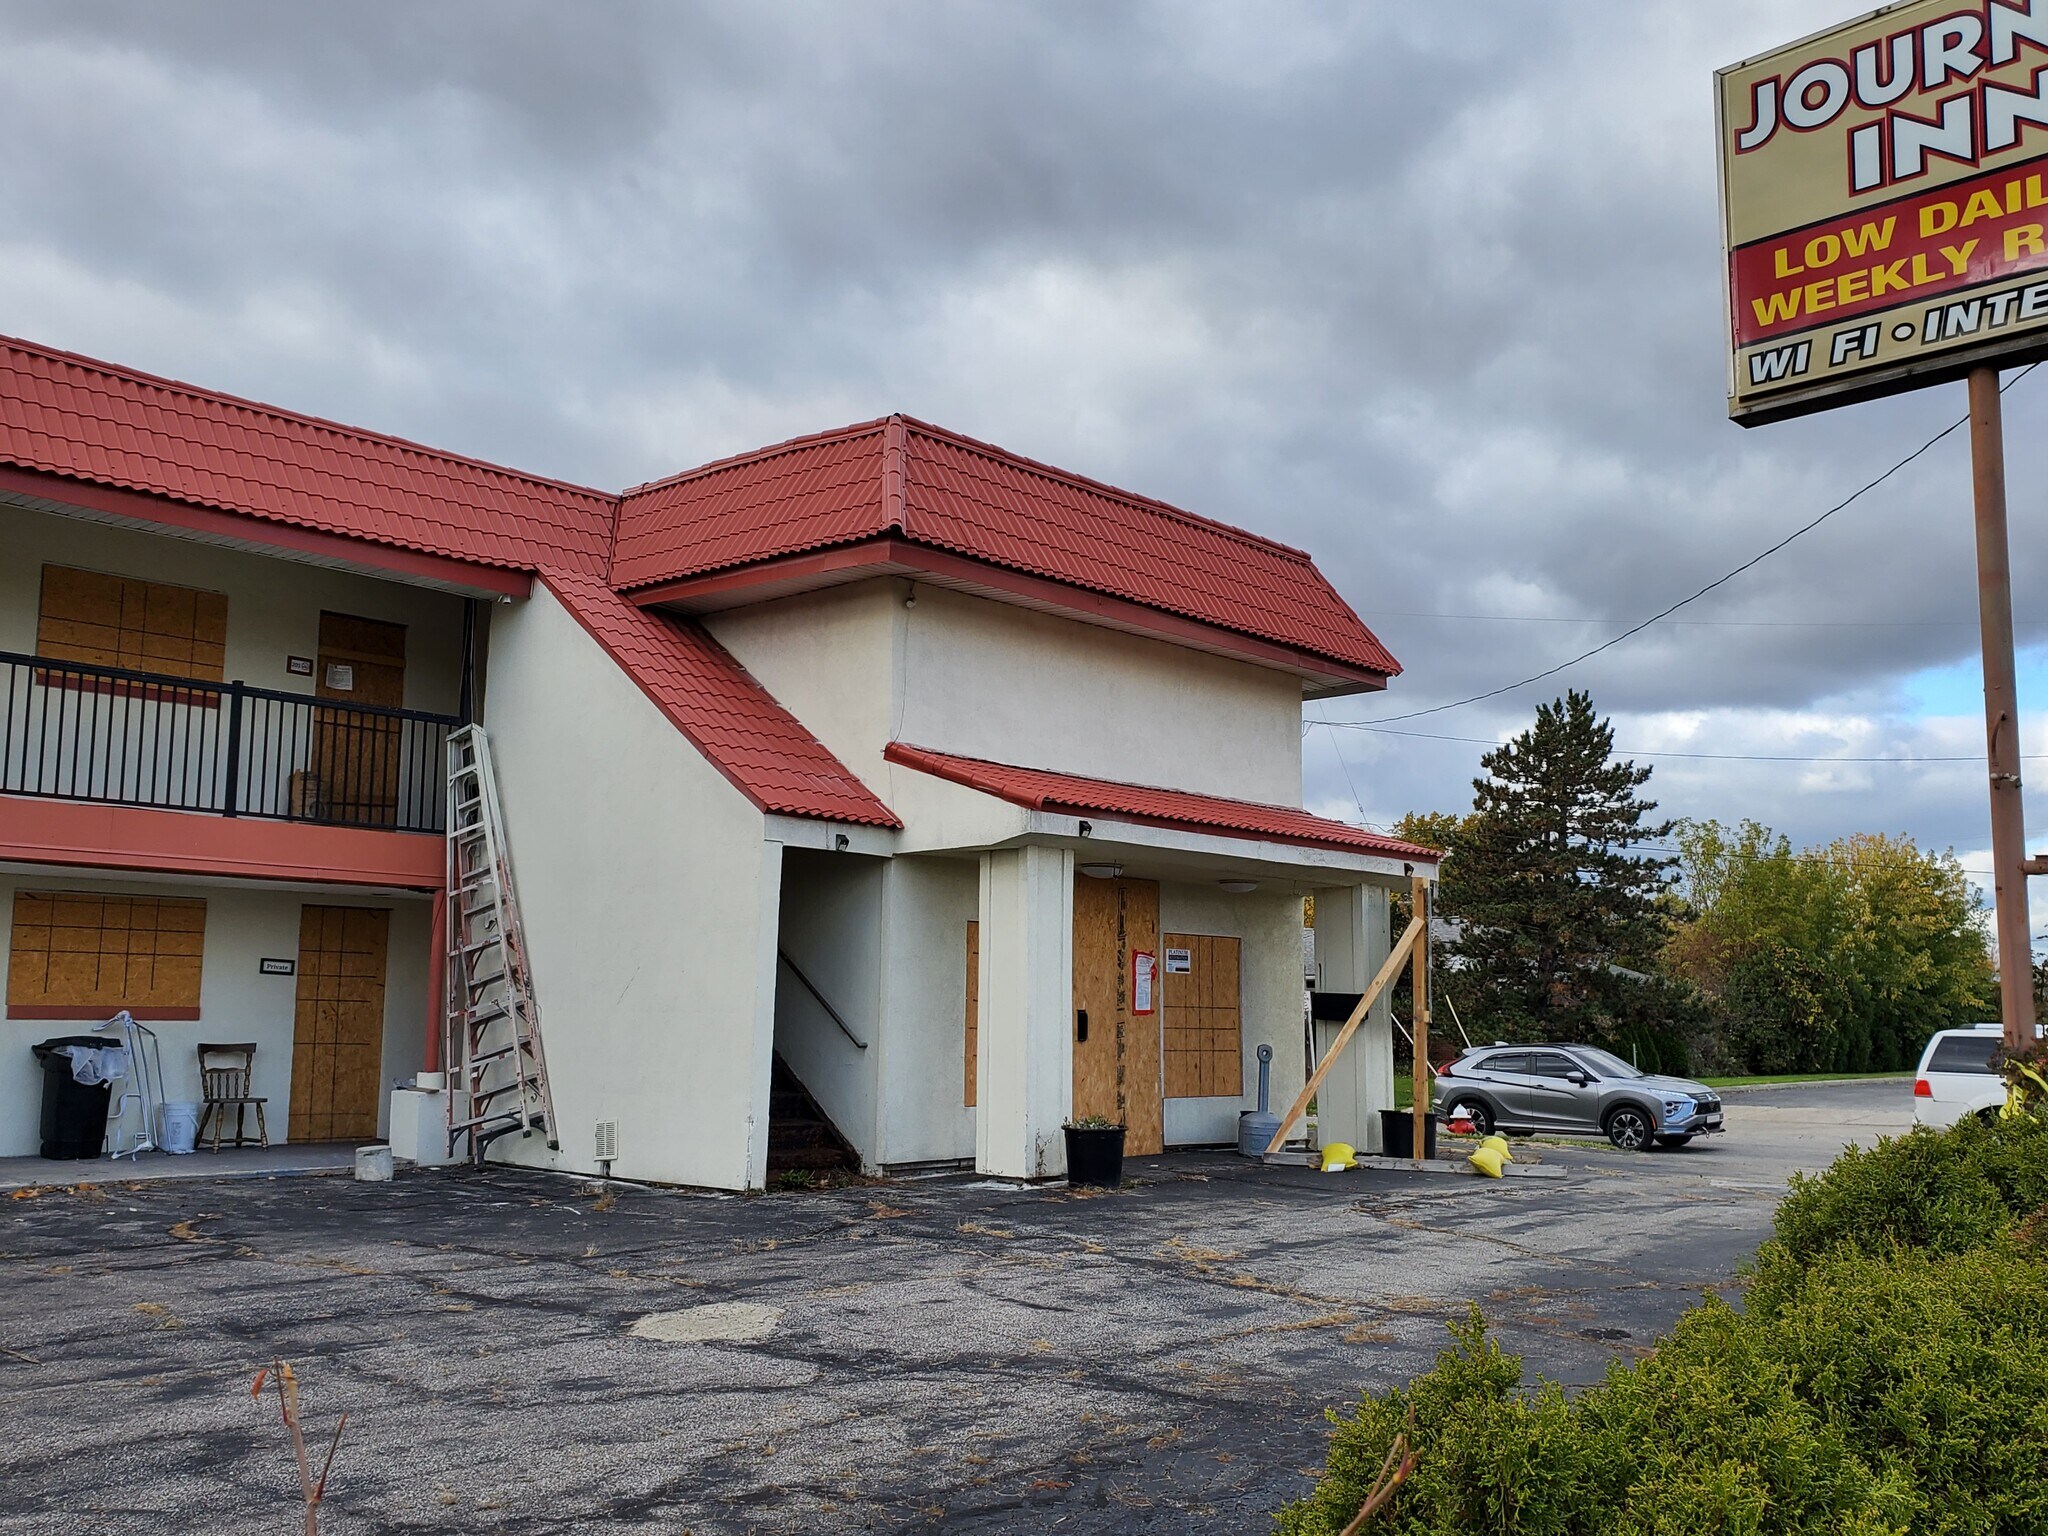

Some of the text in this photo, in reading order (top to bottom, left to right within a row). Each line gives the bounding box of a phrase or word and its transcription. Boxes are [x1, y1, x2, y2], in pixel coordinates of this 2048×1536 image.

[1738, 0, 2048, 151] JOURN
[1852, 69, 2048, 192] INN
[1751, 223, 2048, 327] WEEKLY R
[1774, 173, 2048, 280] LOW DAIL
[1750, 283, 2048, 385] WI FI INTE
[266, 963, 288, 971] Private
